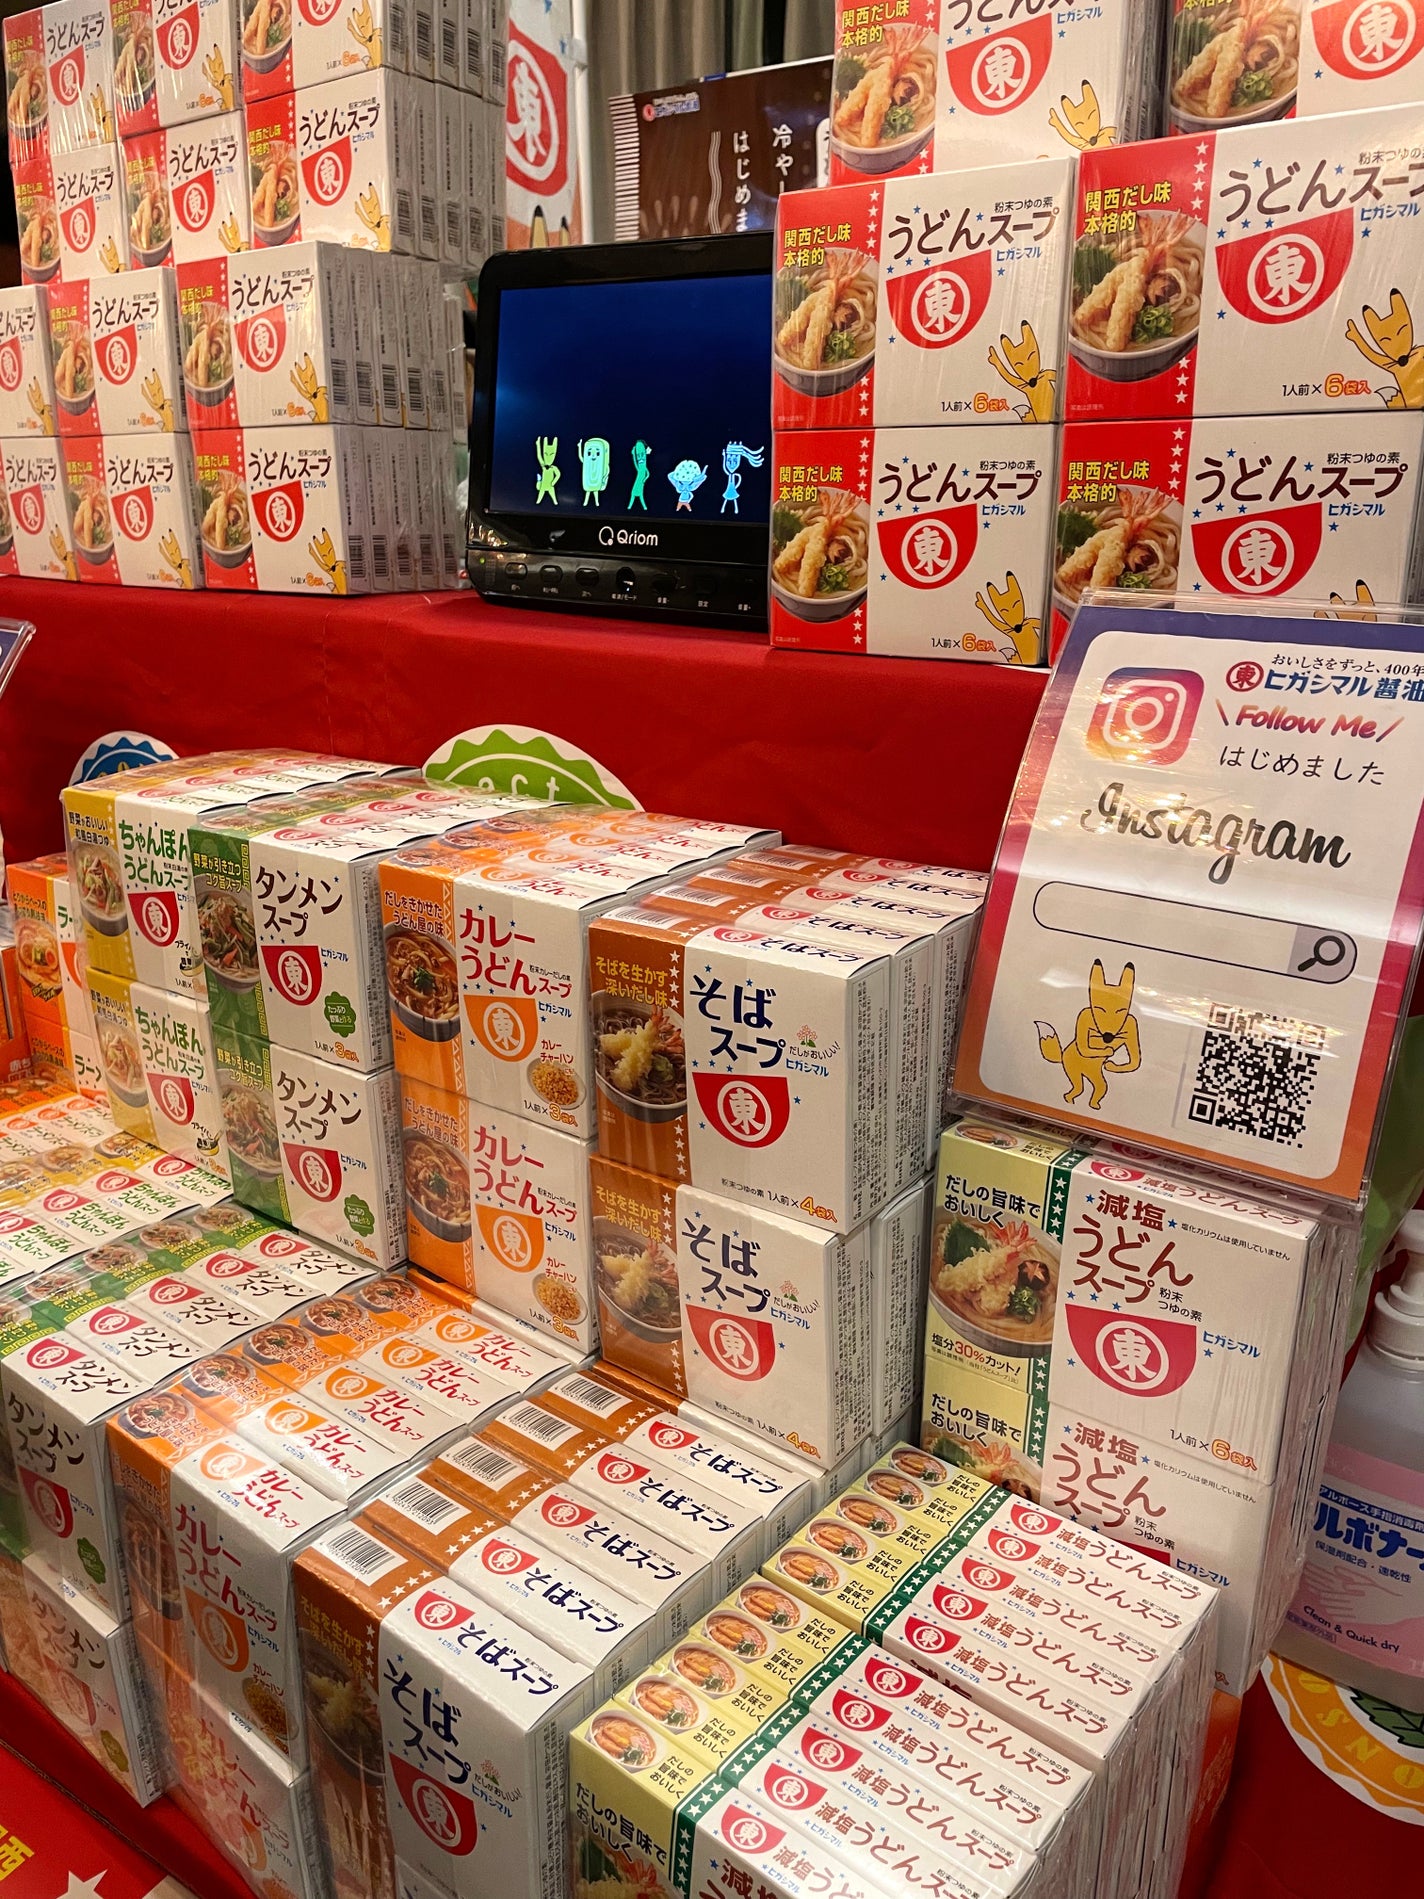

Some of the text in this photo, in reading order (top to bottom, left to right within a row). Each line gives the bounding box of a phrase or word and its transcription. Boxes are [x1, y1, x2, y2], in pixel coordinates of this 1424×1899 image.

[842, 0, 910, 29] 関西だし味
[1057, 6, 1103, 25] ヒガシマル
[842, 25, 883, 49] 本格的
[299, 104, 381, 146] うどんスープ
[169, 144, 238, 178] うどんスープ
[994, 197, 1053, 213] 粉末つゆの素
[1085, 182, 1172, 213] 関西だし味
[1361, 202, 1421, 221] ヒガシマル
[784, 222, 852, 248] 関西だし味
[888, 207, 1060, 260] うどんスープ
[1084, 210, 1137, 236] 本格的
[784, 247, 825, 268] 本格的
[996, 246, 1042, 262] ヒガシマル
[1264, 244, 1313, 305] 東
[232, 273, 315, 311] うどんスープ
[1282, 373, 1371, 398] 1人前×6袋入
[107, 455, 174, 487] うどんスープ
[248, 449, 332, 481] うどんスープ
[779, 466, 843, 483] 関西だし味
[980, 460, 1036, 471] 粉末つゆの素
[1068, 461, 1150, 482] 関西だし味
[1327, 452, 1400, 465] 粉末つゆの素
[779, 485, 818, 502] 本格的
[879, 461, 1042, 505] うどんスープ
[1067, 483, 1118, 503] 本格的
[1195, 455, 1409, 504] うどんスープ
[982, 504, 1026, 517] ヒガシマル
[1328, 503, 1385, 517] ヒガシマル
[617, 530, 659, 546] Qriom
[913, 527, 949, 576] 東
[1264, 670, 1424, 702] ヒガシマル醤油
[1236, 704, 1325, 734] Follow
[1219, 745, 1385, 785] はじめました
[1080, 781, 1351, 885] Instagram
[193, 853, 240, 875] 野菜が引き立つ
[206, 873, 243, 893] コク旨スープ
[256, 866, 342, 914] タンメン
[262, 904, 309, 937] スープ
[385, 890, 443, 920] だしをきかせた
[393, 910, 444, 938] うどん屋の味
[460, 908, 536, 948] カレー
[760, 934, 864, 964] そばスープ
[461, 945, 573, 999] うどんスープ
[595, 956, 668, 987] そばを生かす
[538, 1000, 573, 1019] ヒガシマル
[605, 978, 669, 1009] 深いだし味
[689, 974, 777, 1031] そば
[136, 1006, 206, 1056] ちゃんぽん
[540, 1039, 562, 1050] カレー
[710, 1026, 786, 1069] スープ
[142, 1038, 205, 1080] うどんスープ
[540, 1051, 574, 1065] チャーハン
[786, 1059, 830, 1078] ヒガシマル
[229, 1072, 264, 1092] コク旨スープ
[276, 1070, 362, 1125] タンメン
[283, 1105, 329, 1141] スープ
[404, 1096, 458, 1133] だしをきかせた
[412, 1115, 459, 1148] うどん屋の味
[473, 1126, 545, 1169] カレー
[595, 1185, 661, 1219] そばを生かす
[721, 1177, 838, 1224] 粉末つゆの素 1人前×4袋入
[944, 1195, 1006, 1229] おいしく
[945, 1173, 1042, 1220] だしの旨味で
[1096, 1189, 1168, 1232] 減塩
[65, 1209, 107, 1238] うどんスープ
[82, 1201, 125, 1230] ちゃんぽん
[605, 1205, 663, 1244] 深いだし味
[681, 1217, 761, 1279] そば
[1072, 1213, 1195, 1287] うどん
[1181, 1221, 1292, 1262] 塩化カリウムは使用していません
[289, 1256, 327, 1275] スープ
[300, 1249, 361, 1277] タンメン
[546, 1257, 567, 1268] カレー
[701, 1266, 771, 1314] スープ
[1073, 1259, 1156, 1305] スープ
[1159, 1286, 1184, 1303] 粉末
[770, 1306, 811, 1331] ヒガシマル
[1158, 1300, 1203, 1322] つゆの素
[467, 1343, 534, 1378] うどんスープ
[484, 1333, 533, 1358] カレー
[931, 1333, 1021, 1376] 塩分30%カット!
[1110, 1330, 1161, 1382] 東
[1202, 1330, 1261, 1359] ヒガシマル
[54, 1369, 95, 1394] スープ
[71, 1359, 131, 1397] タンメン
[357, 1399, 426, 1441] うどんスープ
[376, 1389, 426, 1418] カレー
[931, 1392, 1023, 1443] だしの旨味で
[9, 1391, 85, 1465] タンメン
[930, 1410, 989, 1448] おいしく
[1072, 1421, 1142, 1467] 減塩
[1168, 1427, 1258, 1471] 1人前×6袋入
[253, 1468, 305, 1500] カレー
[688, 1442, 784, 1495] そばスープ
[956, 1474, 981, 1488] だしの
[1053, 1443, 1167, 1519] うどん
[1153, 1459, 1257, 1505] 塩化カリウムは使用していません
[945, 1486, 977, 1503] おいしく
[950, 1480, 976, 1495] 旨味で
[1053, 1482, 1131, 1528] スープ
[175, 1504, 242, 1569] カレー
[1133, 1526, 1177, 1551] つゆの素
[1135, 1515, 1159, 1533] 粉末
[1314, 1502, 1424, 1571] ルボナー
[1056, 1528, 1202, 1601] 減塩うどんスープ
[1176, 1557, 1232, 1588] ヒガシマル
[525, 1567, 625, 1635] そばスープ
[1034, 1554, 1182, 1631] 減塩うどんスープ
[1303, 1605, 1331, 1628] Clean
[1335, 1624, 1342, 1634] &
[1346, 1630, 1377, 1648] Quick
[1381, 1640, 1399, 1653] dry
[456, 1622, 560, 1696] そばスープ
[383, 1657, 463, 1747] そば
[952, 1645, 1108, 1736] 減塩うどんスープ
[403, 1716, 472, 1785] スープ
[913, 1689, 1073, 1788] 減塩うどんスープ
[658, 1762, 688, 1785] 旨味で
[668, 1755, 694, 1777] だしの
[472, 1784, 513, 1818] ヒガシマル
[650, 1772, 685, 1799] おいしく
[847, 1782, 880, 1808] ヒガシマル
[576, 1782, 668, 1865] だしの旨味で
[576, 1803, 633, 1862] おいしく
[850, 1763, 1016, 1872] 減塩うどんスープ
